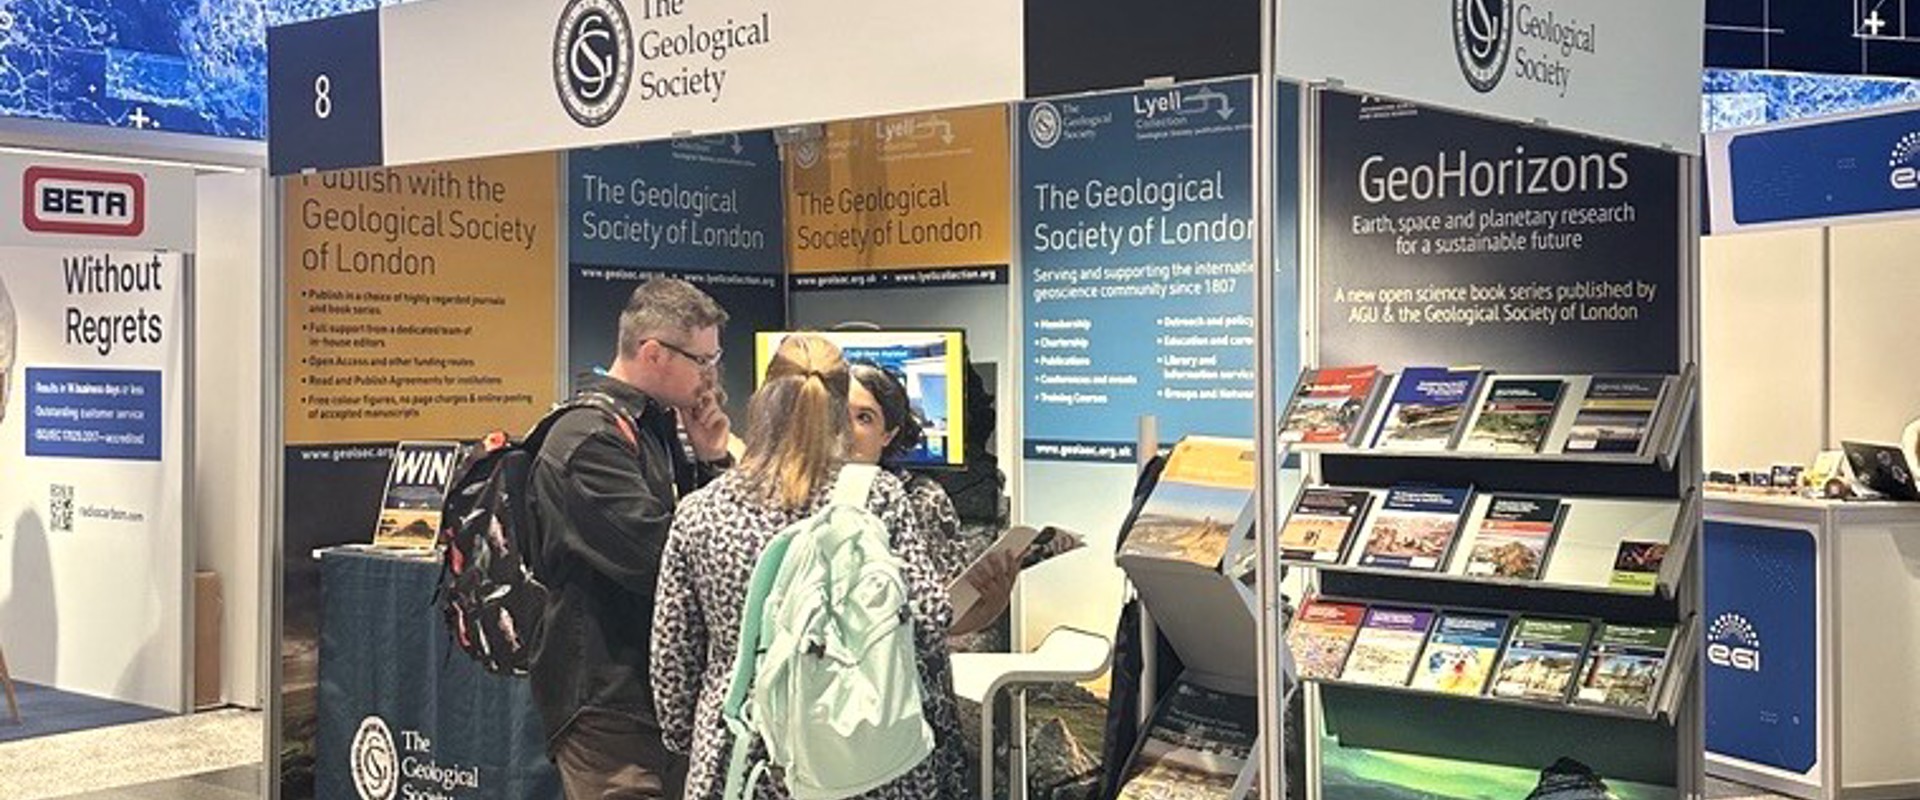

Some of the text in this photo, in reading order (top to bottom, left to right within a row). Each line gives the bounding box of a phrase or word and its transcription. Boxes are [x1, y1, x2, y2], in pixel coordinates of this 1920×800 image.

[641, 13, 769, 60] Geological
[1517, 4, 1595, 57] Geological
[641, 68, 725, 103] Society
[1516, 47, 1570, 98] Society
[315, 75, 332, 119] 8
[1133, 89, 1182, 119] Lyell
[1063, 112, 1113, 129] Geological
[408, 170, 461, 199] with
[468, 174, 506, 203] the
[1034, 170, 1224, 212] The Geological
[1359, 145, 1629, 203] GeoHorizons
[42, 187, 127, 217] BETA
[583, 174, 739, 217] The Geological
[797, 180, 950, 217] The Geological
[302, 198, 536, 250] Geological Society
[582, 210, 764, 250] Society of London
[797, 216, 983, 255] Society of London
[1034, 220, 1123, 255] Society
[1128, 215, 1155, 247] of
[1352, 201, 1637, 236] Earth, space and planetary research
[302, 241, 436, 275] of London
[1396, 229, 1584, 255] for a sustainable future
[64, 253, 162, 294] Without
[1033, 261, 1193, 285] Serving and supporting the
[1033, 277, 1236, 303] geoscience community since 1807
[309, 288, 344, 301] Publish
[432, 295, 470, 306] regarded
[309, 304, 327, 313] and
[328, 304, 352, 314] book
[1334, 279, 1657, 305] A new open science book series published by
[330, 323, 364, 335] support
[397, 325, 439, 335] dedicated
[1348, 301, 1638, 327] AGU & the Geological Society of London
[66, 308, 162, 356] Regrets
[309, 355, 335, 368] Open
[336, 357, 368, 366] Access
[370, 357, 387, 366] and
[388, 357, 412, 366] other
[414, 357, 446, 369] funding
[309, 375, 334, 386] Read
[335, 376, 353, 386] and
[354, 375, 387, 386] Publish
[390, 375, 443, 388] Agreements
[321, 408, 363, 420] accepted
[395, 449, 456, 485] WIN
[401, 730, 431, 753] The
[401, 756, 480, 791] Geological
